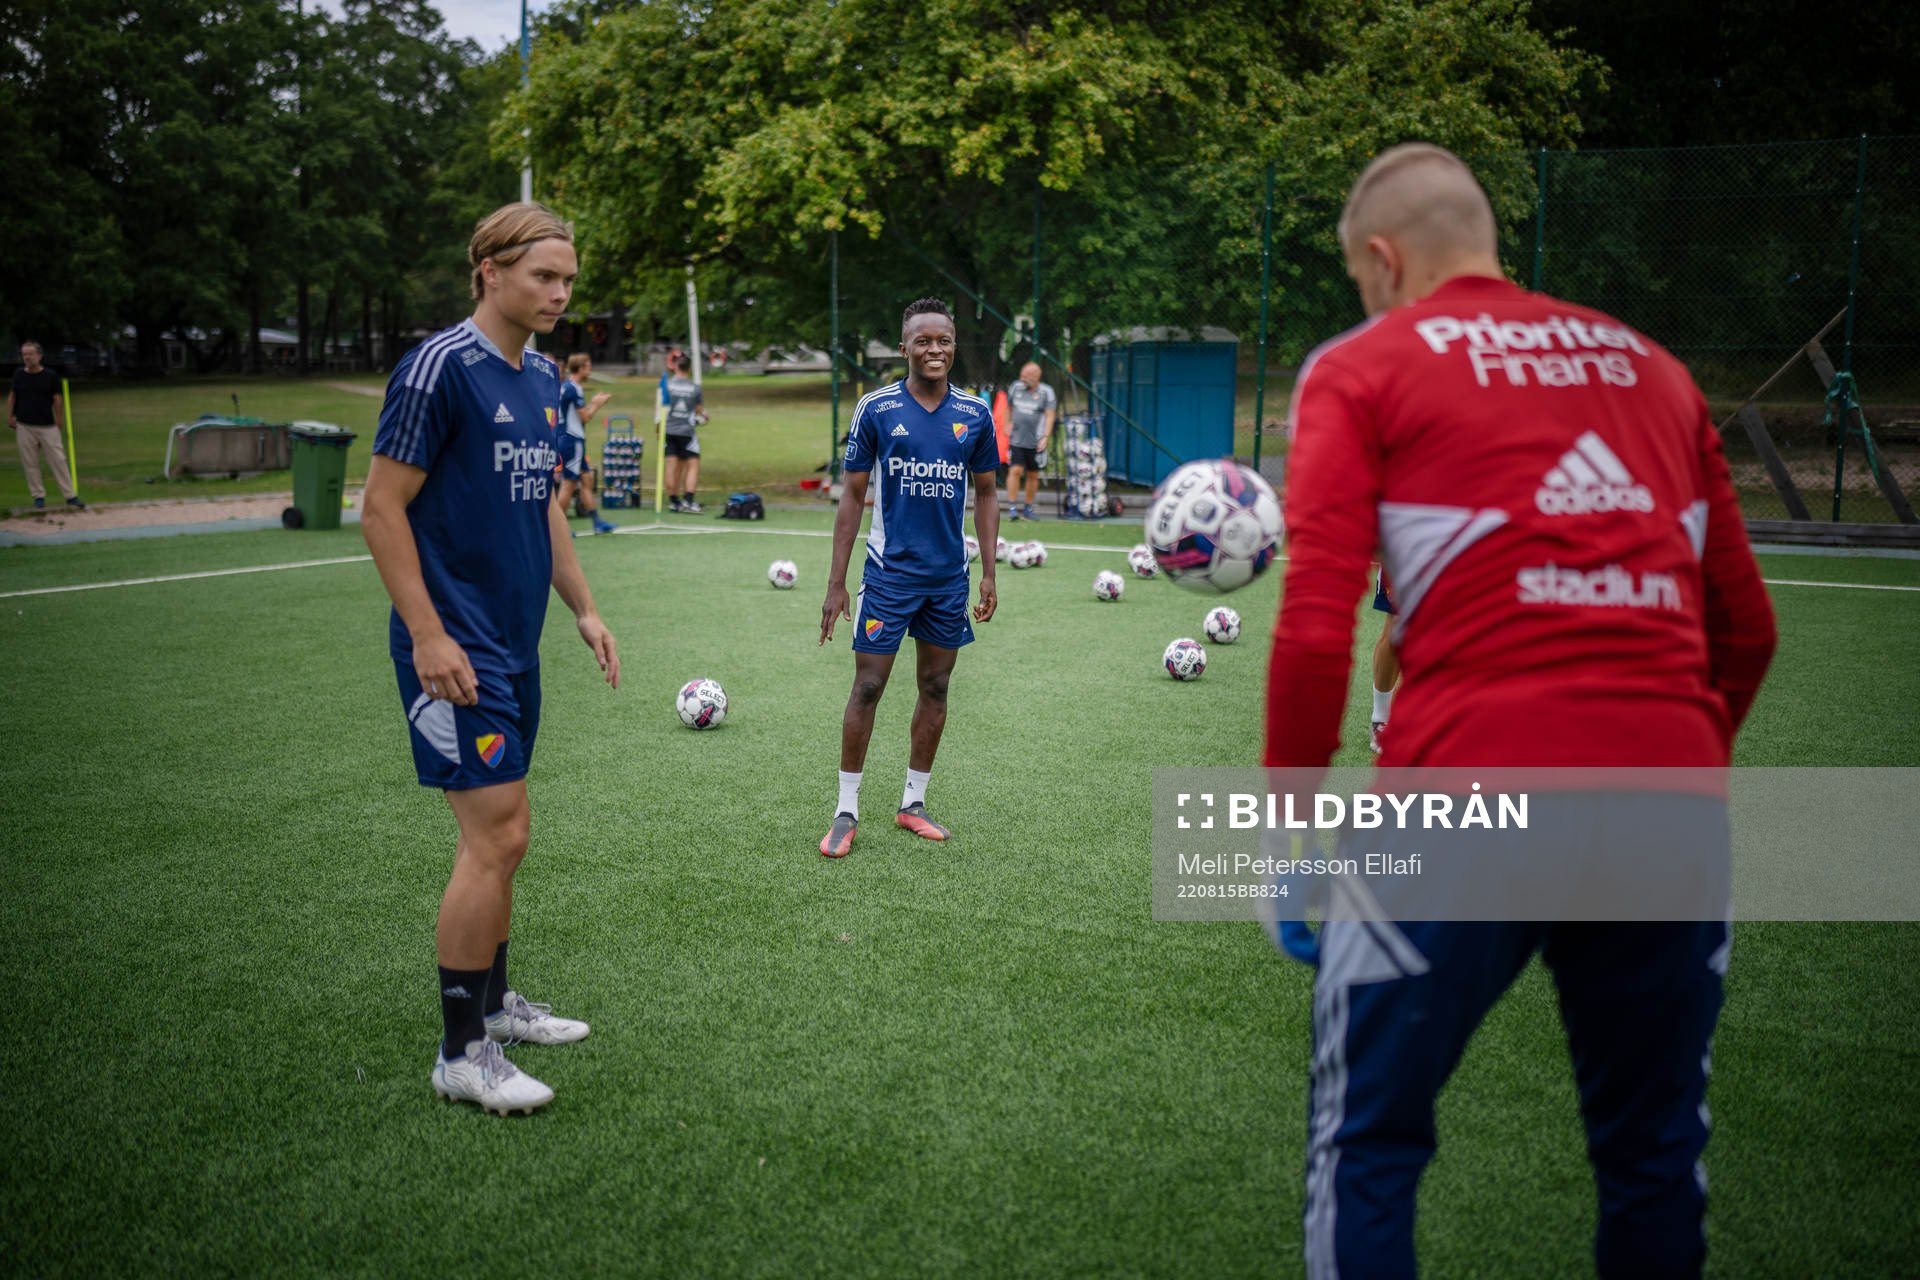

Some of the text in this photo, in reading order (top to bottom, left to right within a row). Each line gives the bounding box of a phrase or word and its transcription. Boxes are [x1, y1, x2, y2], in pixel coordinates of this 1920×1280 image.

[1414, 312, 1650, 357] Prioritet
[1466, 346, 1638, 388] Finans
[494, 440, 556, 472] Priorite
[888, 457, 964, 480] Prioritet
[511, 471, 547, 502] Fina
[900, 476, 955, 499] Finans
[1534, 484, 1655, 515] adidas
[1158, 471, 1203, 534] SELECT
[1515, 559, 1683, 611] stadium
[700, 689, 725, 704] SELECT
